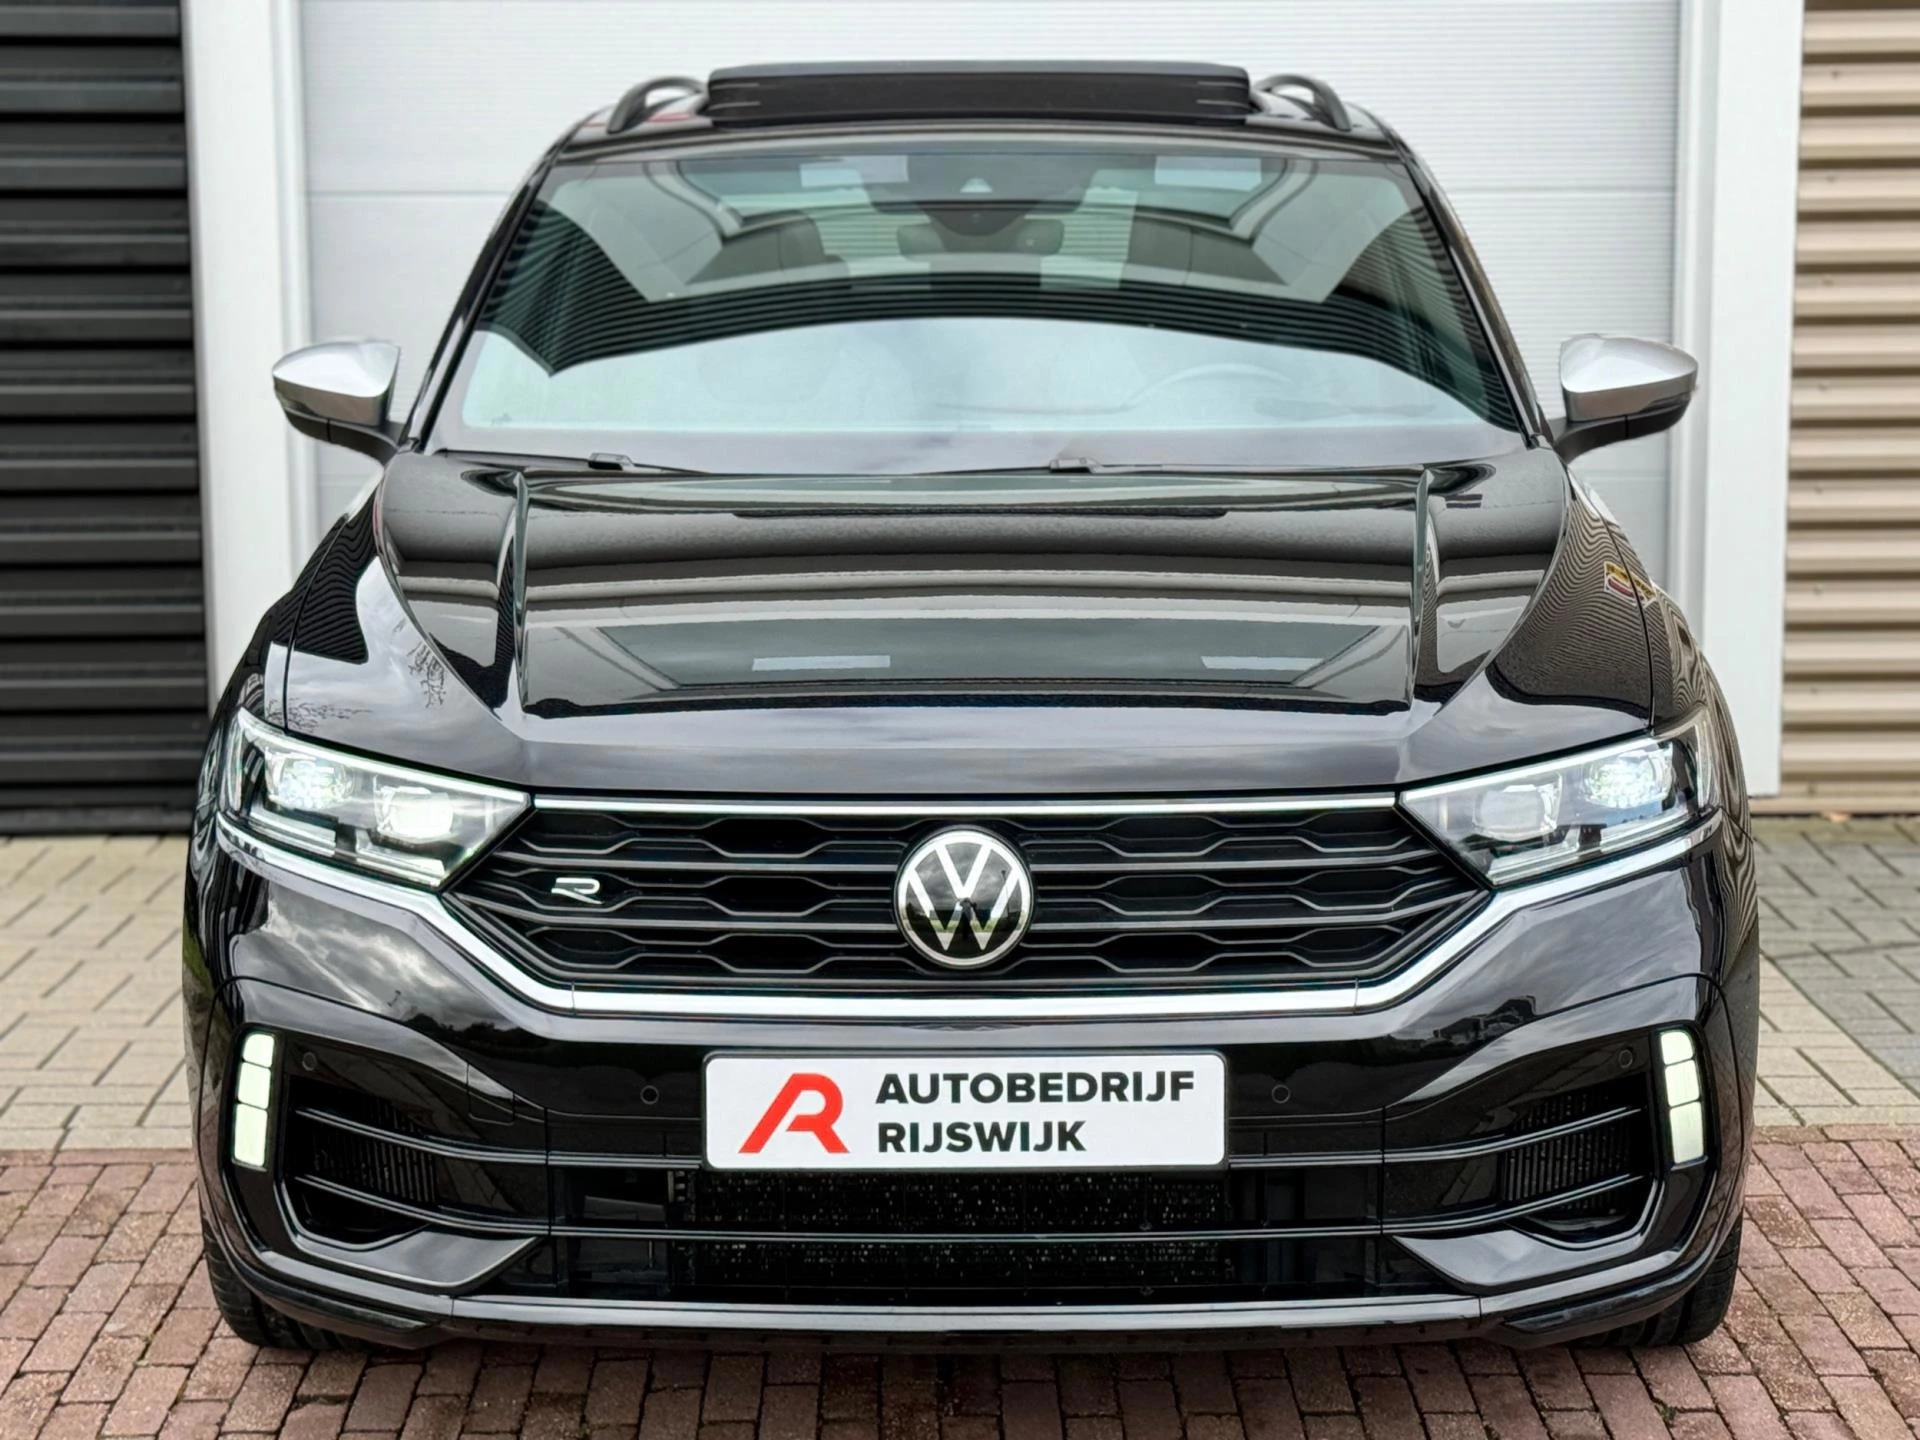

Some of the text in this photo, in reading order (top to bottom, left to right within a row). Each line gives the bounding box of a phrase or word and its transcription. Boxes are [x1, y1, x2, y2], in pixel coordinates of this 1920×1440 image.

[551, 877, 603, 905] R
[875, 1070, 1195, 1104] AUTOBEDRIJF
[877, 1120, 1087, 1153] RIJSWIJK
